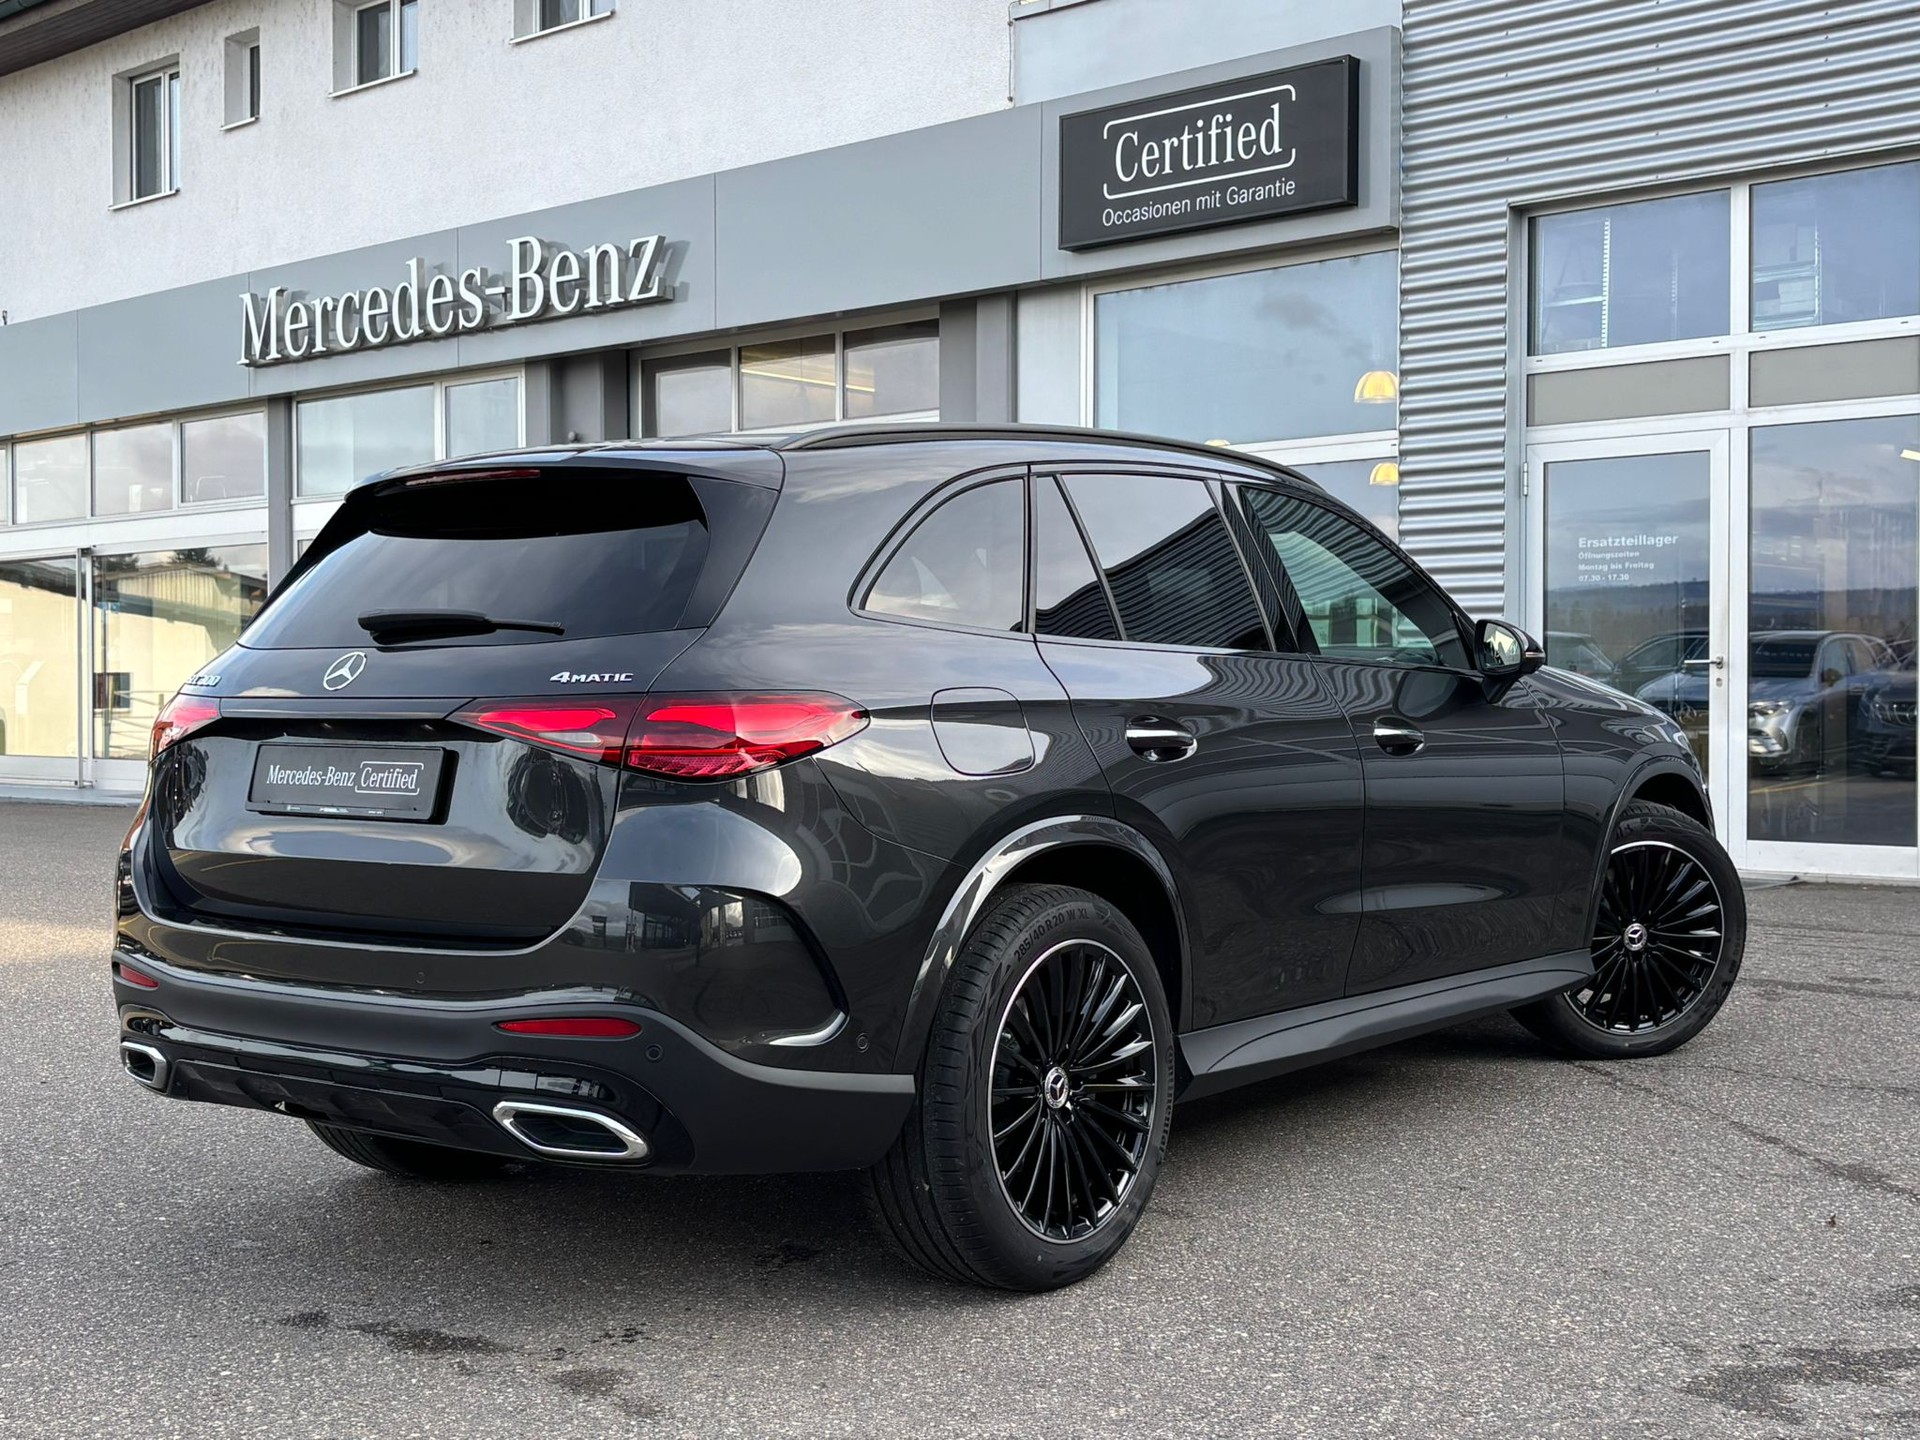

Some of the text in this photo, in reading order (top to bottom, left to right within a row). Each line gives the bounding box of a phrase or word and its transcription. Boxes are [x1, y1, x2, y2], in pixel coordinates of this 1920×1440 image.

[1115, 102, 1283, 182] Certified
[1102, 177, 1296, 227] Occasionen mit Garantie
[236, 234, 668, 366] Mercedes-Benz
[1578, 534, 1679, 548] Ersatzteillager
[549, 671, 635, 684] 4MATIC
[266, 764, 418, 789] Mercedes-Benz Certified
[1013, 923, 1046, 962] 285/40
[1078, 908, 1090, 919] XL
